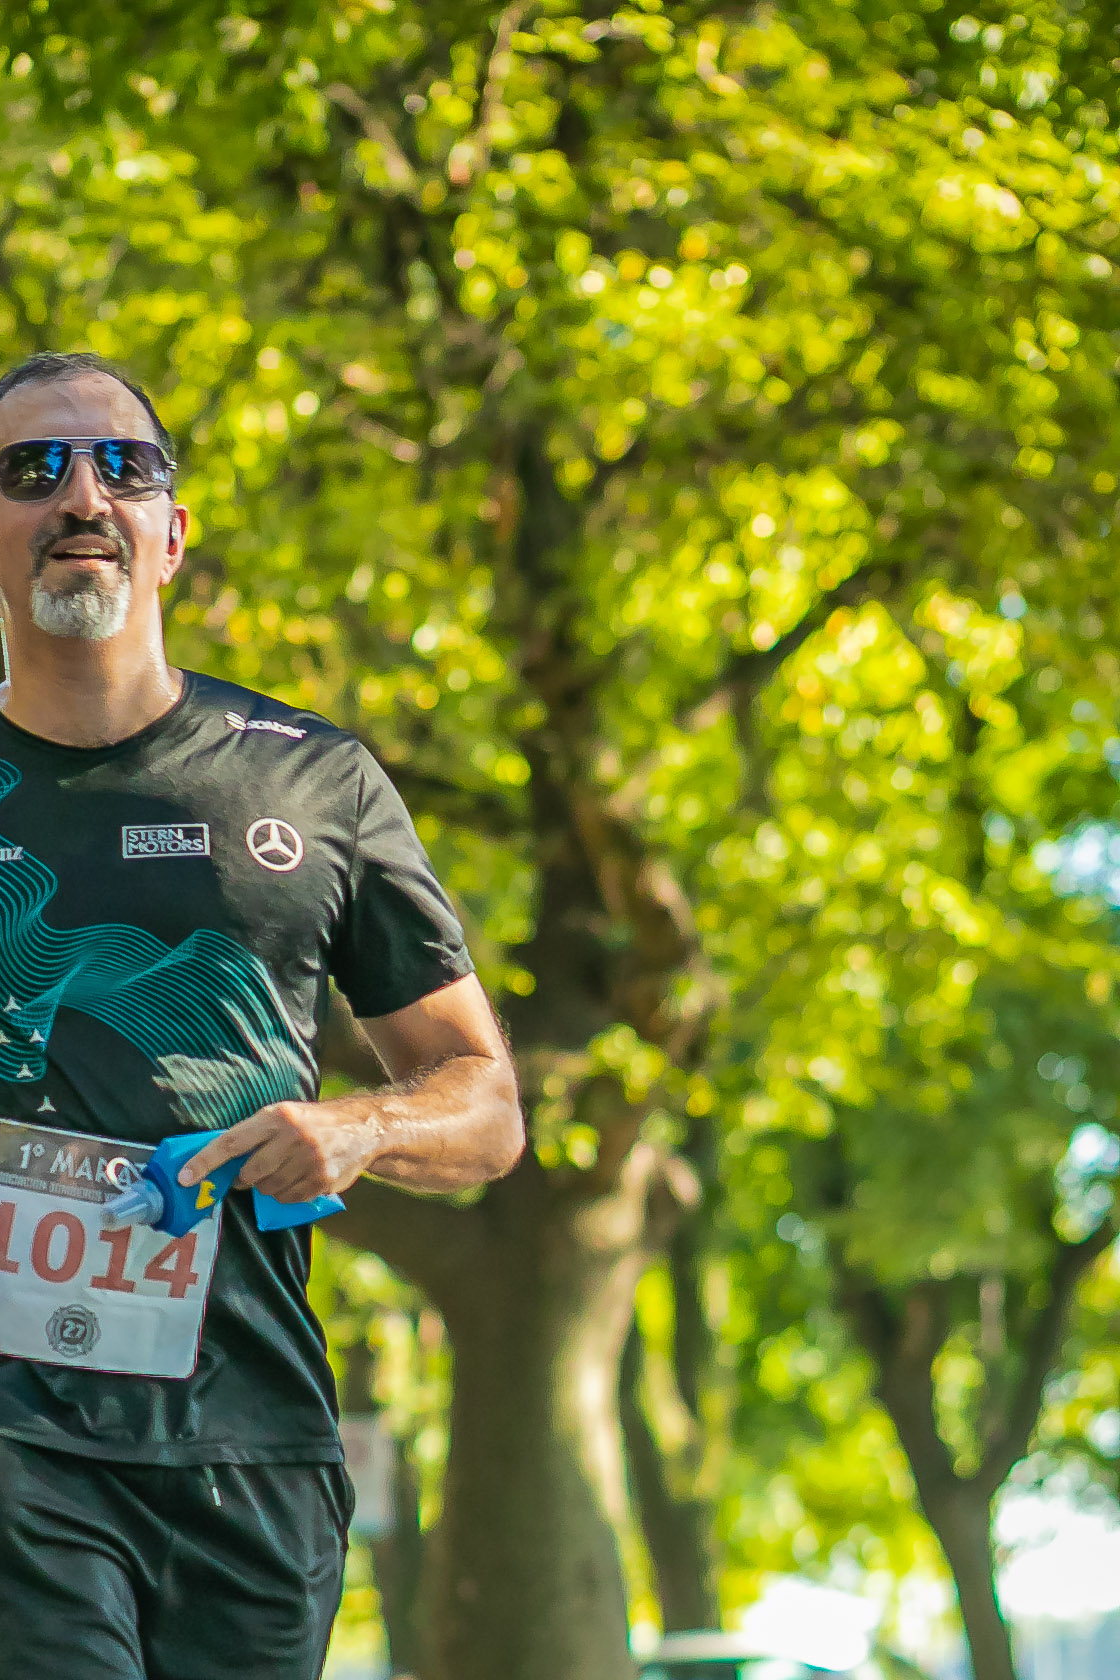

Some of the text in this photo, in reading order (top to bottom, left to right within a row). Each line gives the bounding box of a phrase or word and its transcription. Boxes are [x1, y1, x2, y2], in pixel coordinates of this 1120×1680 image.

[128, 829, 183, 842] STERN
[128, 839, 204, 853] MOTORS
[58, 1319, 85, 1338] 27
